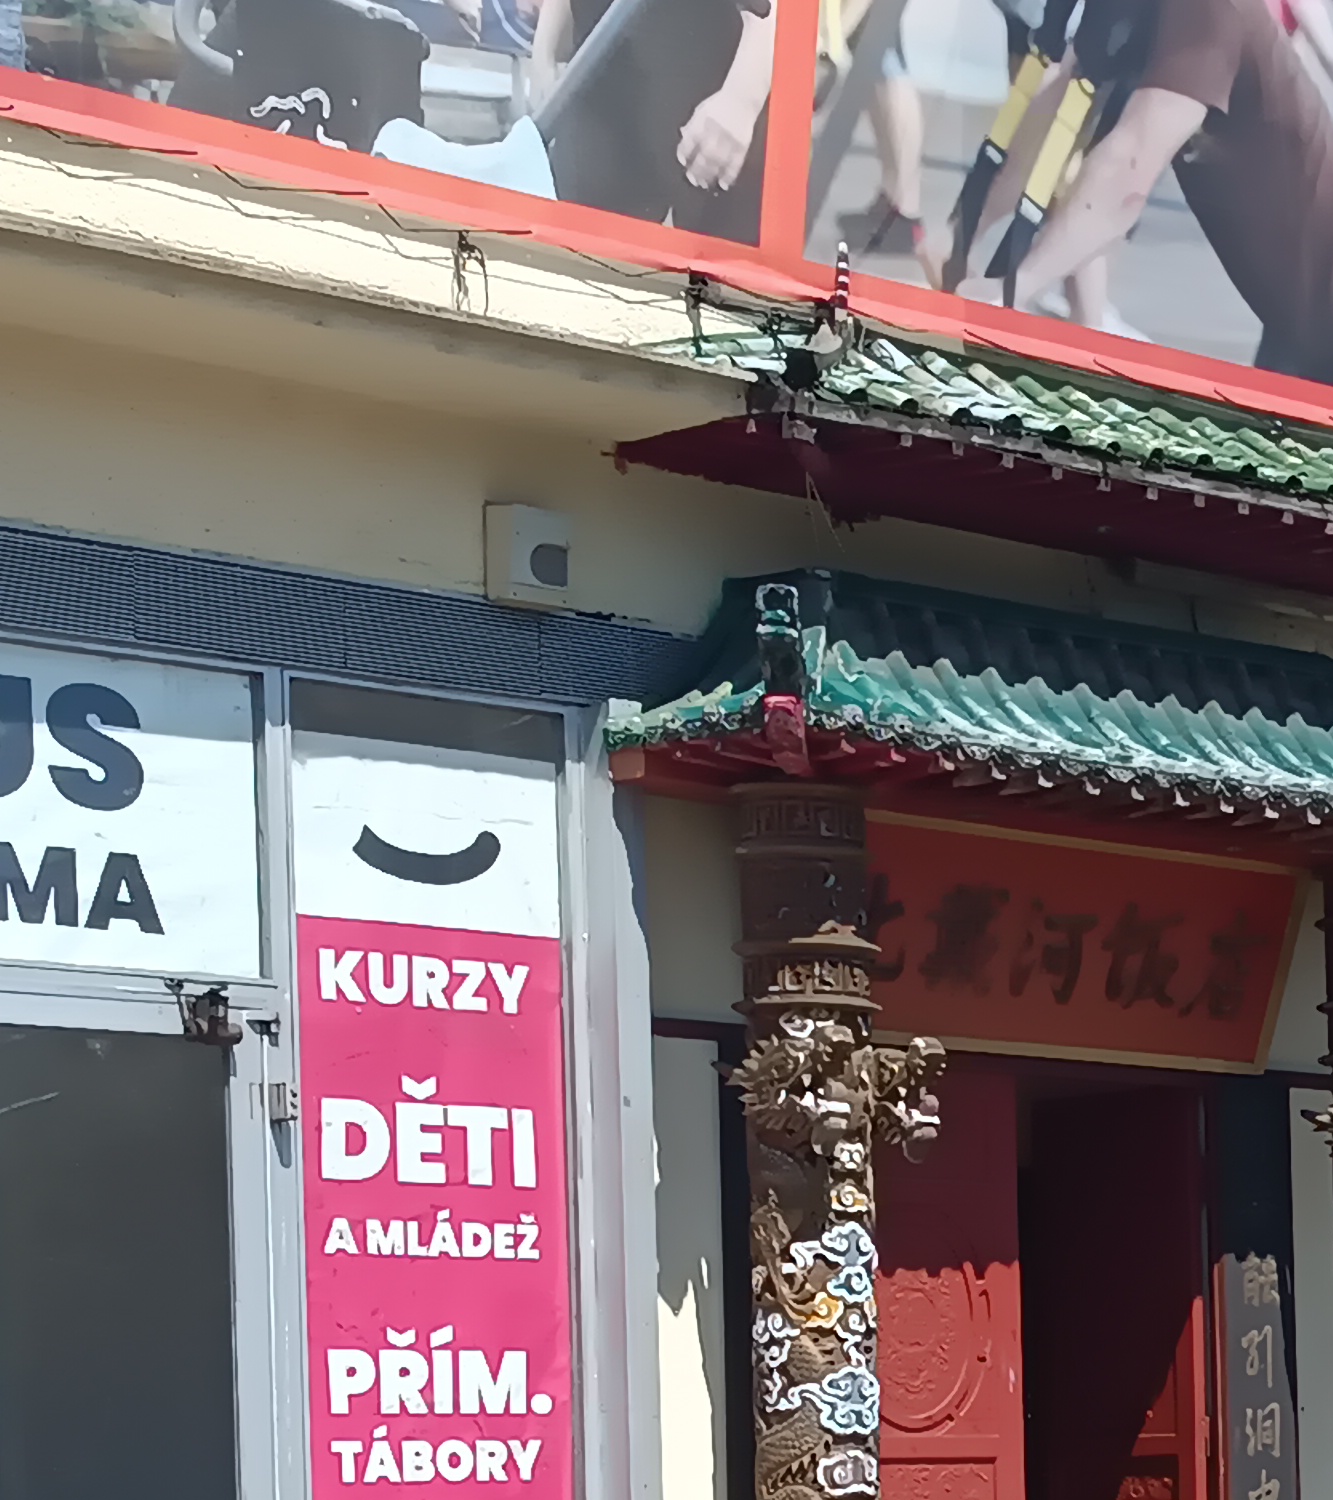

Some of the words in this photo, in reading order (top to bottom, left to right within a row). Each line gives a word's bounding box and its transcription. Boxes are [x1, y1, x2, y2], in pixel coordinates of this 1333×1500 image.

[317, 948, 530, 1014] KURZY
[320, 1074, 538, 1189] DĚTI
[324, 1217, 358, 1255] A
[365, 1208, 541, 1260] MLÁDEŽ
[326, 1325, 554, 1415] PŘÍM.
[330, 1425, 542, 1483] TÁBORY
